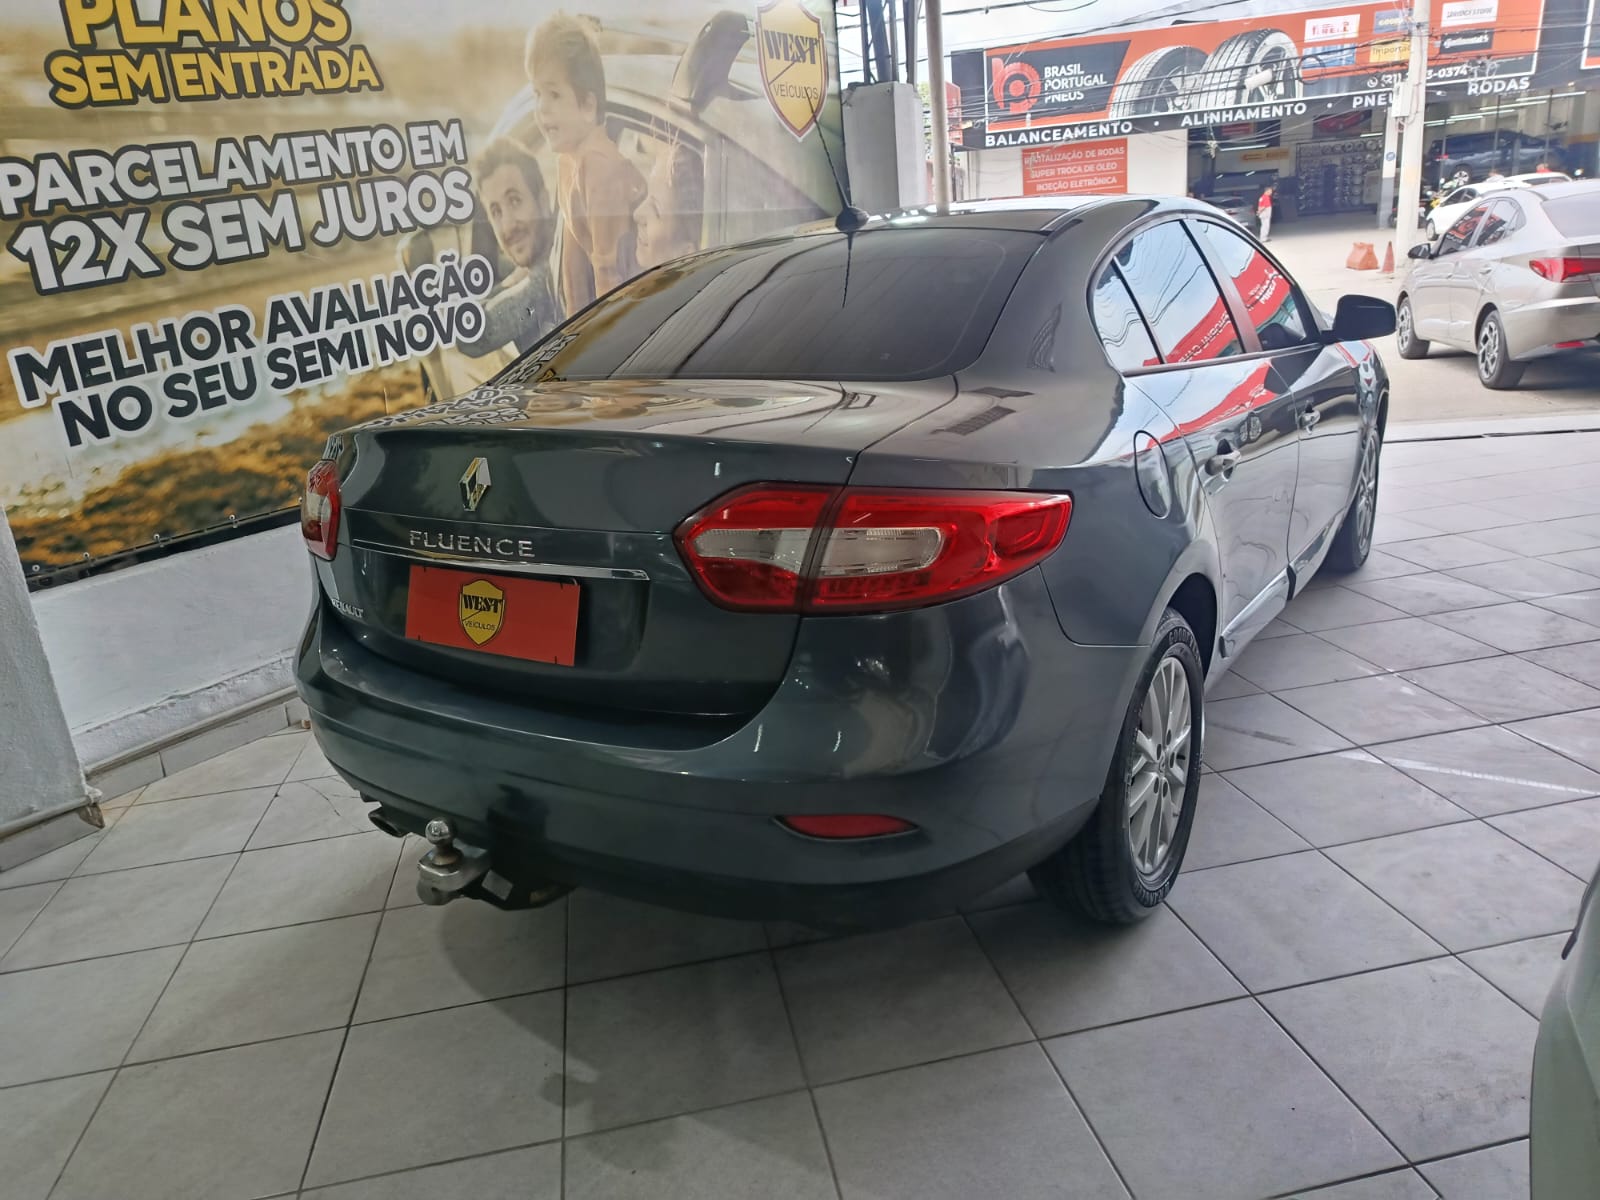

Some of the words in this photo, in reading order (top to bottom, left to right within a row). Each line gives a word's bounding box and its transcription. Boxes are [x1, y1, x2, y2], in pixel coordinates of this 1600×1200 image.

[67, 0, 350, 45] PLANOS
[763, 30, 819, 65] WEST
[50, 52, 166, 103] SEM
[171, 47, 380, 97] ENTRADA
[1043, 63, 1085, 78] BRASIL
[1043, 73, 1108, 91] PORTUGAL
[985, 120, 1133, 147] BALANCEAMENTO
[1181, 102, 1307, 127] ALINHAMENTO
[1352, 92, 1394, 109] PNE
[1467, 76, 1531, 96] RODAS
[0, 129, 402, 216] PARCELAMENTO
[407, 121, 466, 166] EM
[9, 213, 161, 290] 12X
[166, 194, 302, 268] SEM
[314, 171, 474, 244] JUROS
[14, 309, 255, 402] MELHOR
[267, 253, 492, 346] AVALIAÇÃO
[57, 384, 153, 447] NO
[163, 355, 257, 418] SEU
[267, 330, 369, 386] SEMI
[379, 303, 484, 362] NOVO
[409, 530, 536, 557] FLUENCE
[463, 594, 502, 613] WEST
